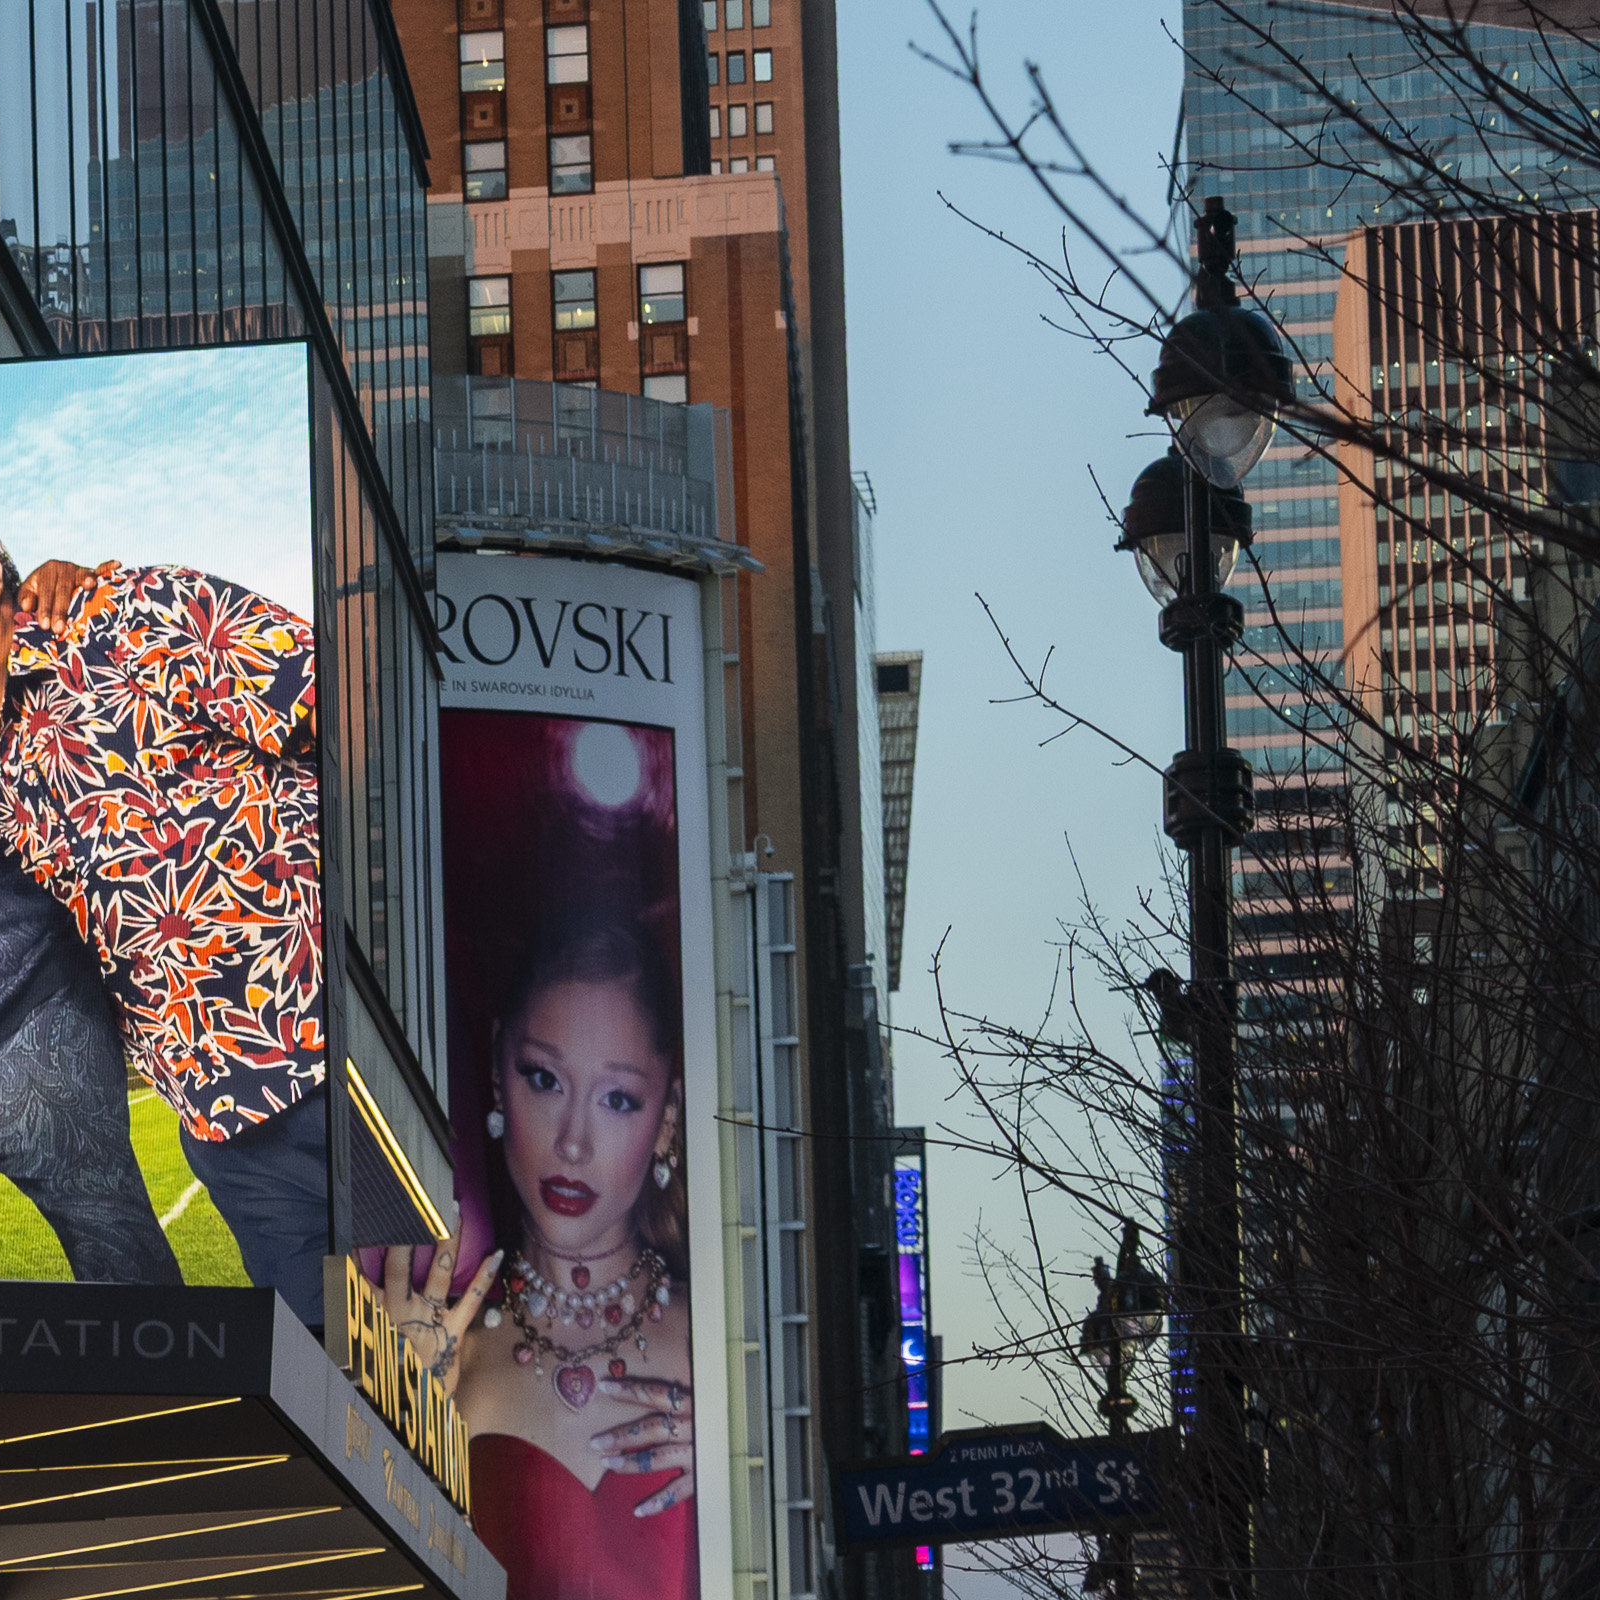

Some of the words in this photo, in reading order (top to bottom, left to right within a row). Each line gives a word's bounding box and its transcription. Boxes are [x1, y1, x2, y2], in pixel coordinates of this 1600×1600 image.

[452, 680, 466, 692] IN
[471, 680, 546, 697] SWAROVSKI
[550, 686, 595, 701] IDYLLIA
[346, 1253, 400, 1431] PENN
[404, 1337, 470, 1515] STATION
[950, 1450, 959, 1463] 2
[961, 1446, 999, 1462] PENN
[1002, 1441, 1046, 1458] PLAZA
[858, 1478, 978, 1526] West
[991, 1460, 1079, 1515] 32nd
[1096, 1459, 1141, 1505] St
